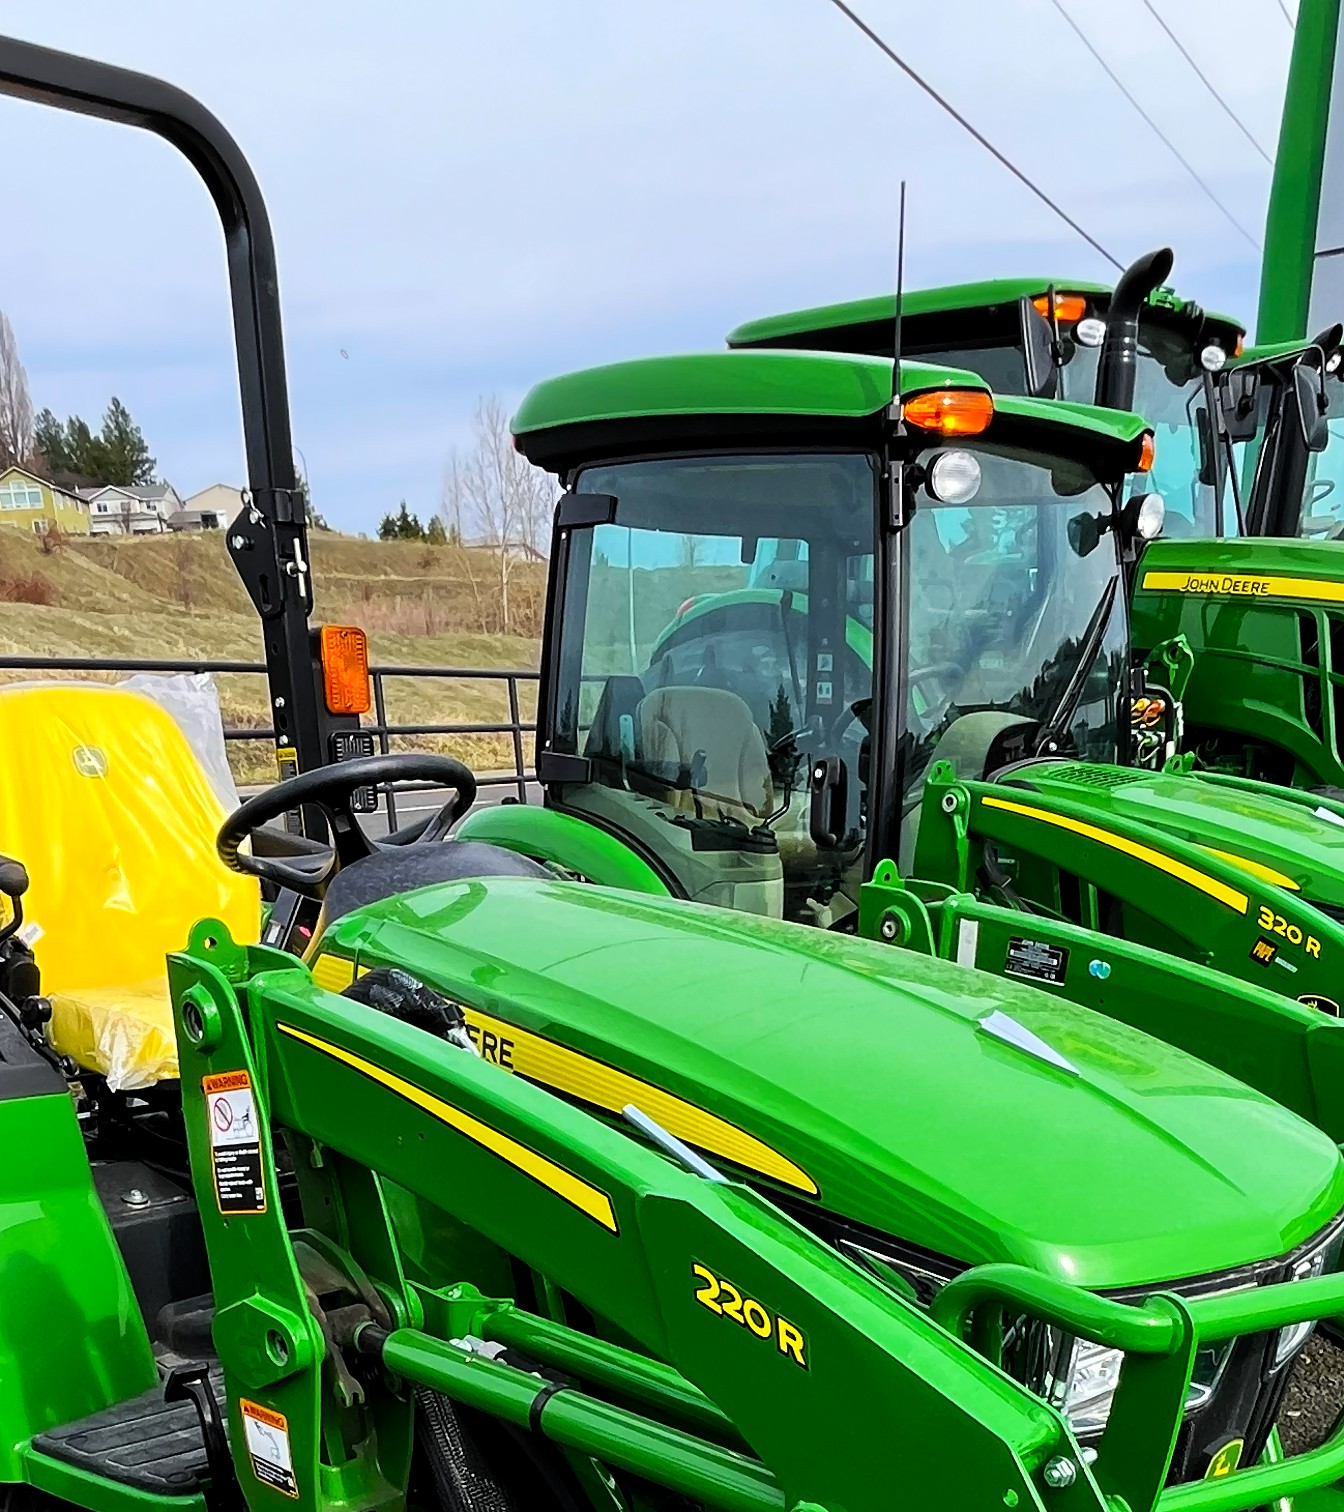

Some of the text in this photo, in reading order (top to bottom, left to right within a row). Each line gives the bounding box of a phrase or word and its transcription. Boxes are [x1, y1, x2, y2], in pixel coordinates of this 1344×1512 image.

[1181, 576, 1271, 595] JOHN DEERE
[1257, 905, 1321, 959] 320 R
[466, 1023, 515, 1070] ERE
[692, 1263, 807, 1366] 220 R
